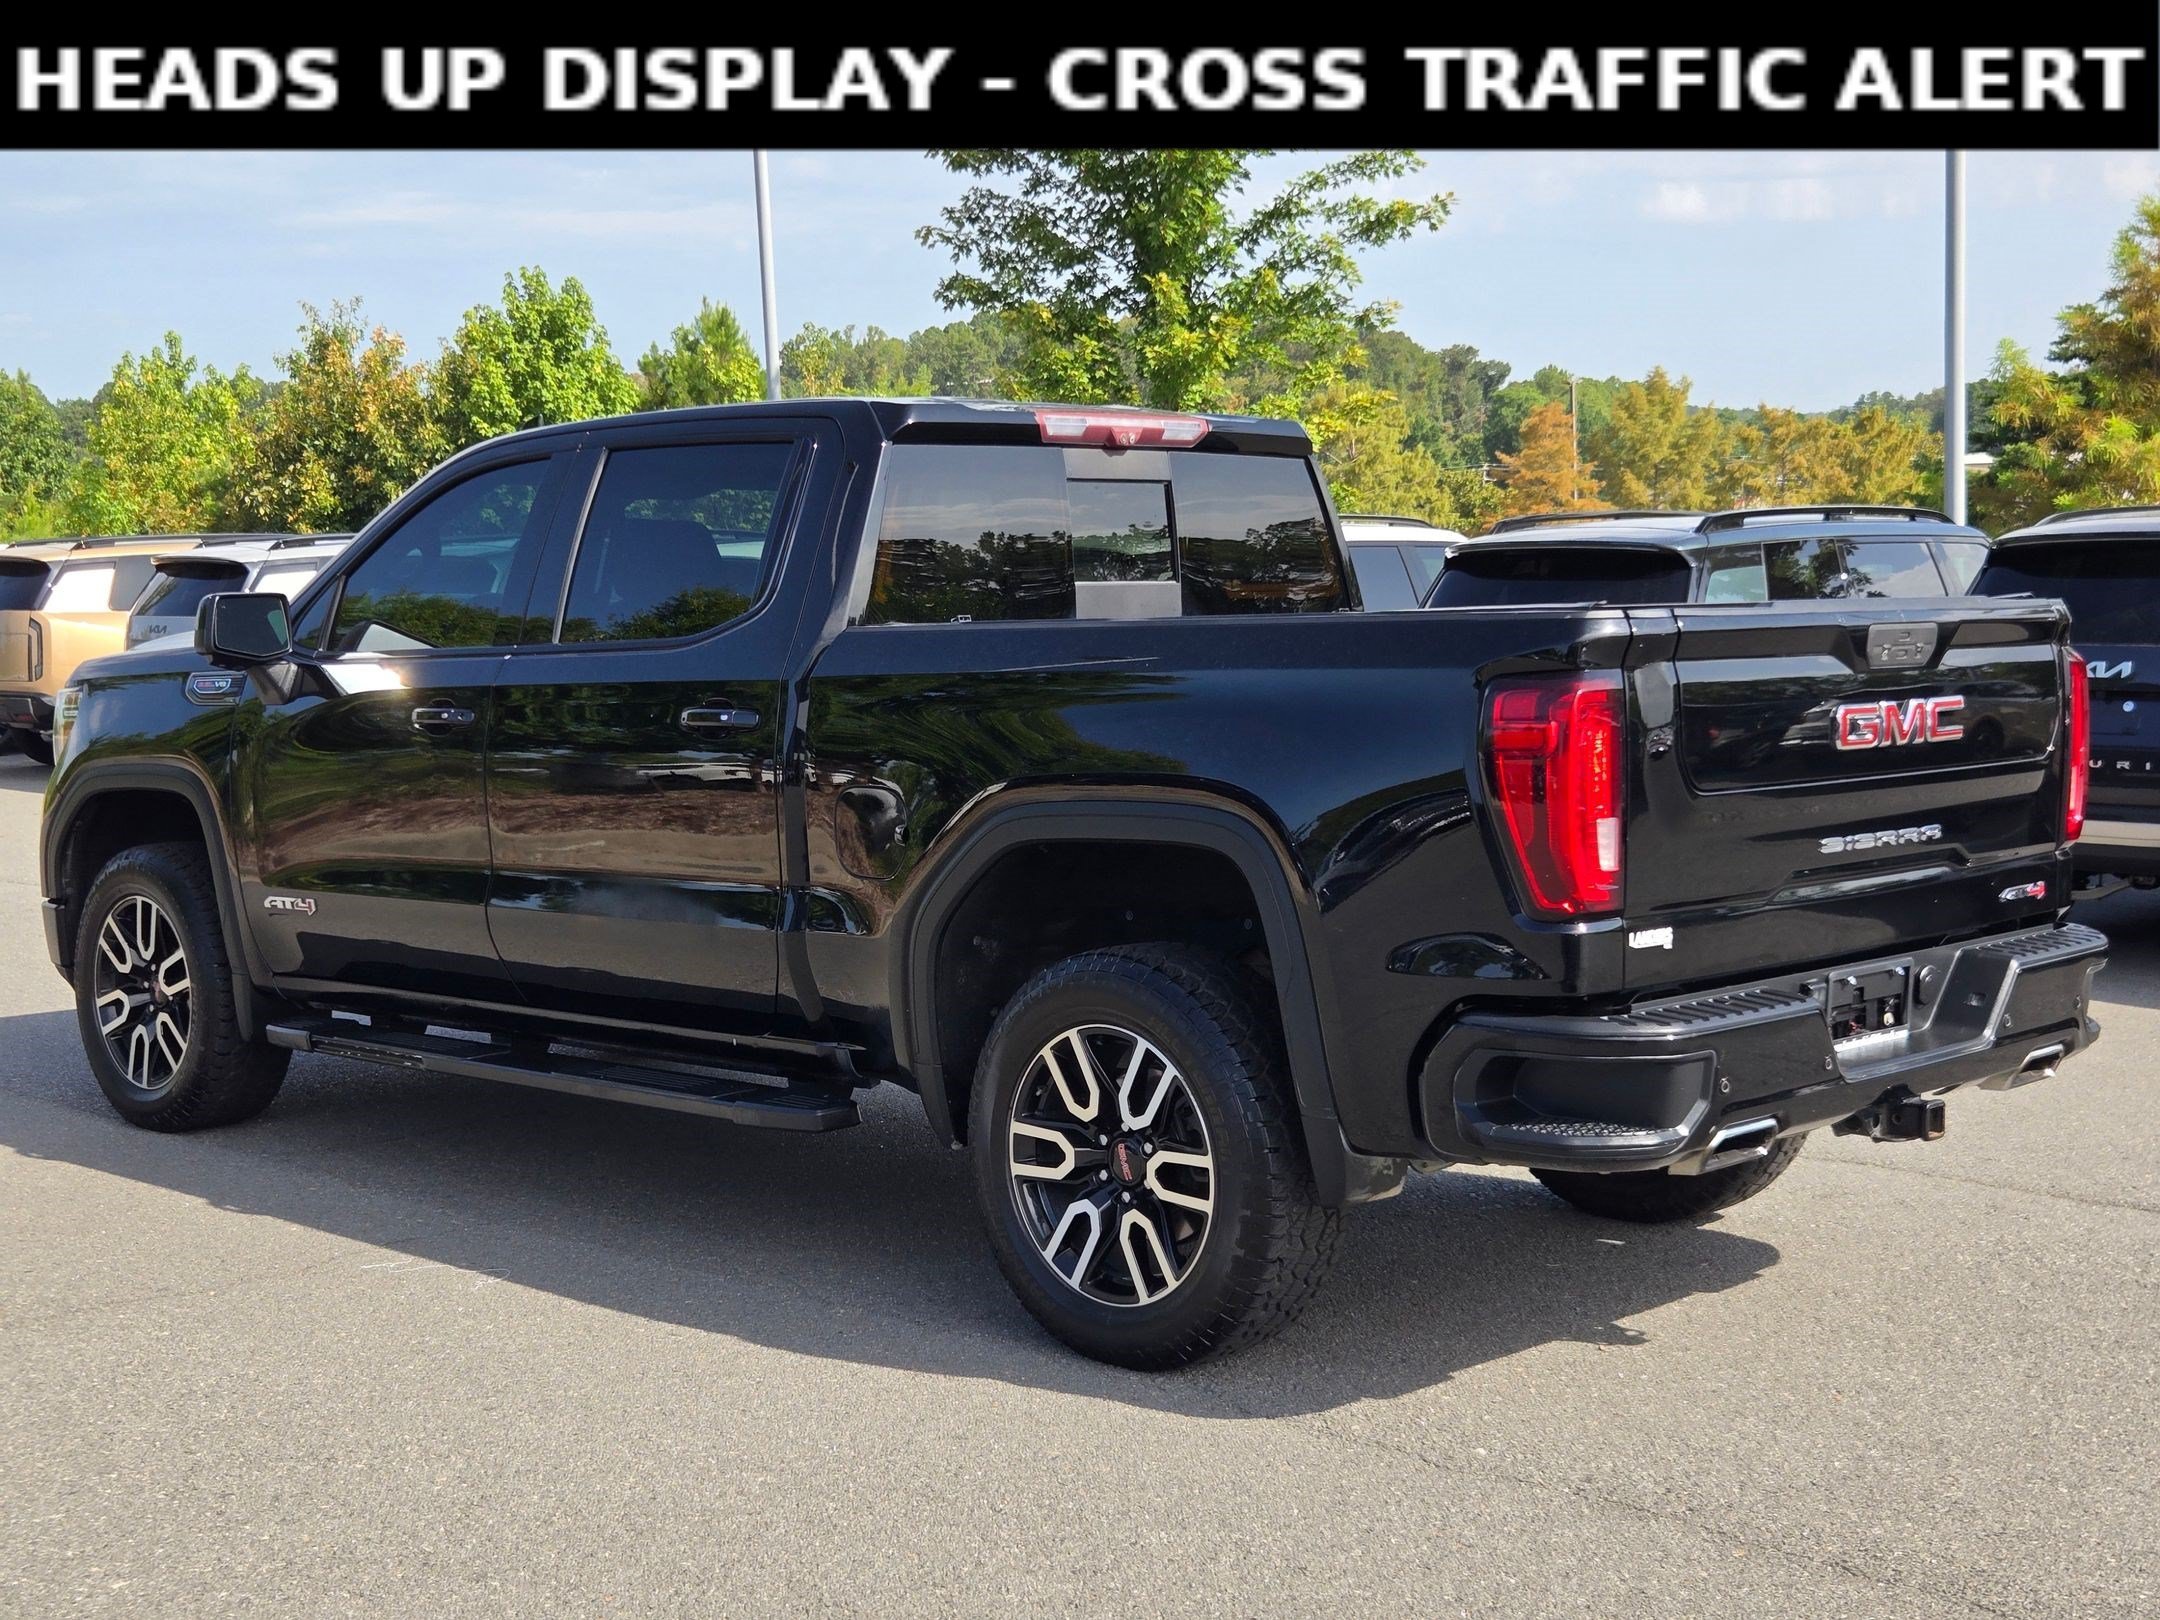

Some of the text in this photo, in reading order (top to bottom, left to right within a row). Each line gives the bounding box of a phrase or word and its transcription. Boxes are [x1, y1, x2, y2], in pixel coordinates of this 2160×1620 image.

[1835, 694, 1965, 750] GMC
[1818, 823, 1943, 854] SIERRA
[263, 895, 318, 917] AT4
